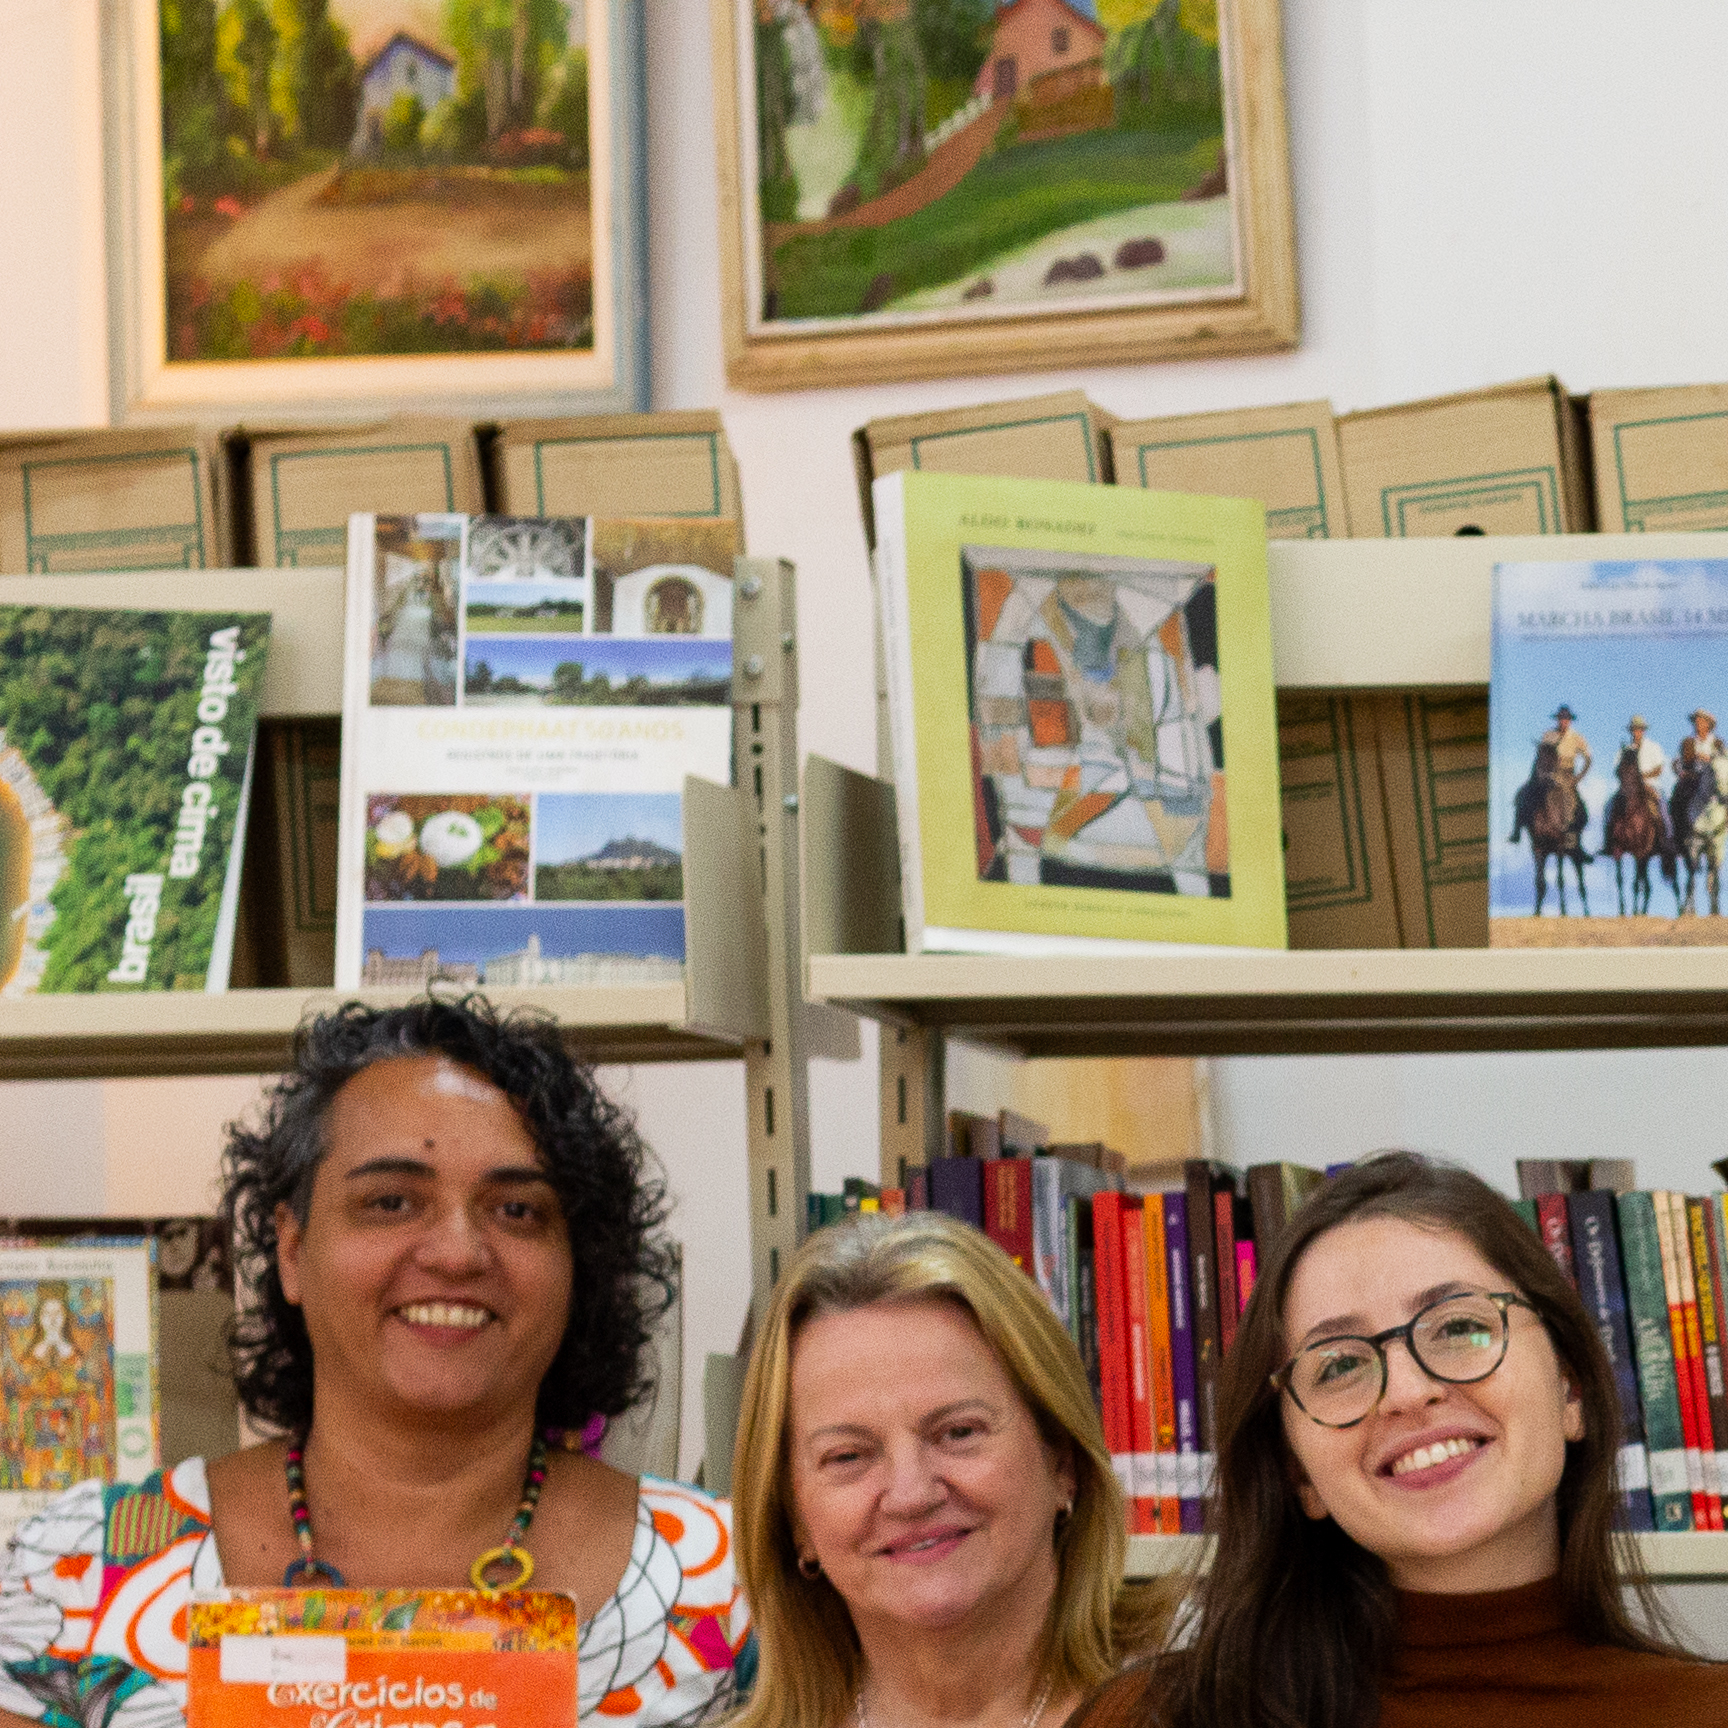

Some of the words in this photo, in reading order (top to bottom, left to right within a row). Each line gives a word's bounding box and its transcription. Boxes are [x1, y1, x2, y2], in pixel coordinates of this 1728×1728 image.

[1516, 609, 1604, 627] MARCHA
[1608, 608, 1674, 626] BRASIL
[198, 624, 242, 722] visto
[190, 725, 222, 778] de
[168, 779, 212, 880] cima
[106, 872, 164, 984] brasil
[468, 1687, 499, 1711] de
